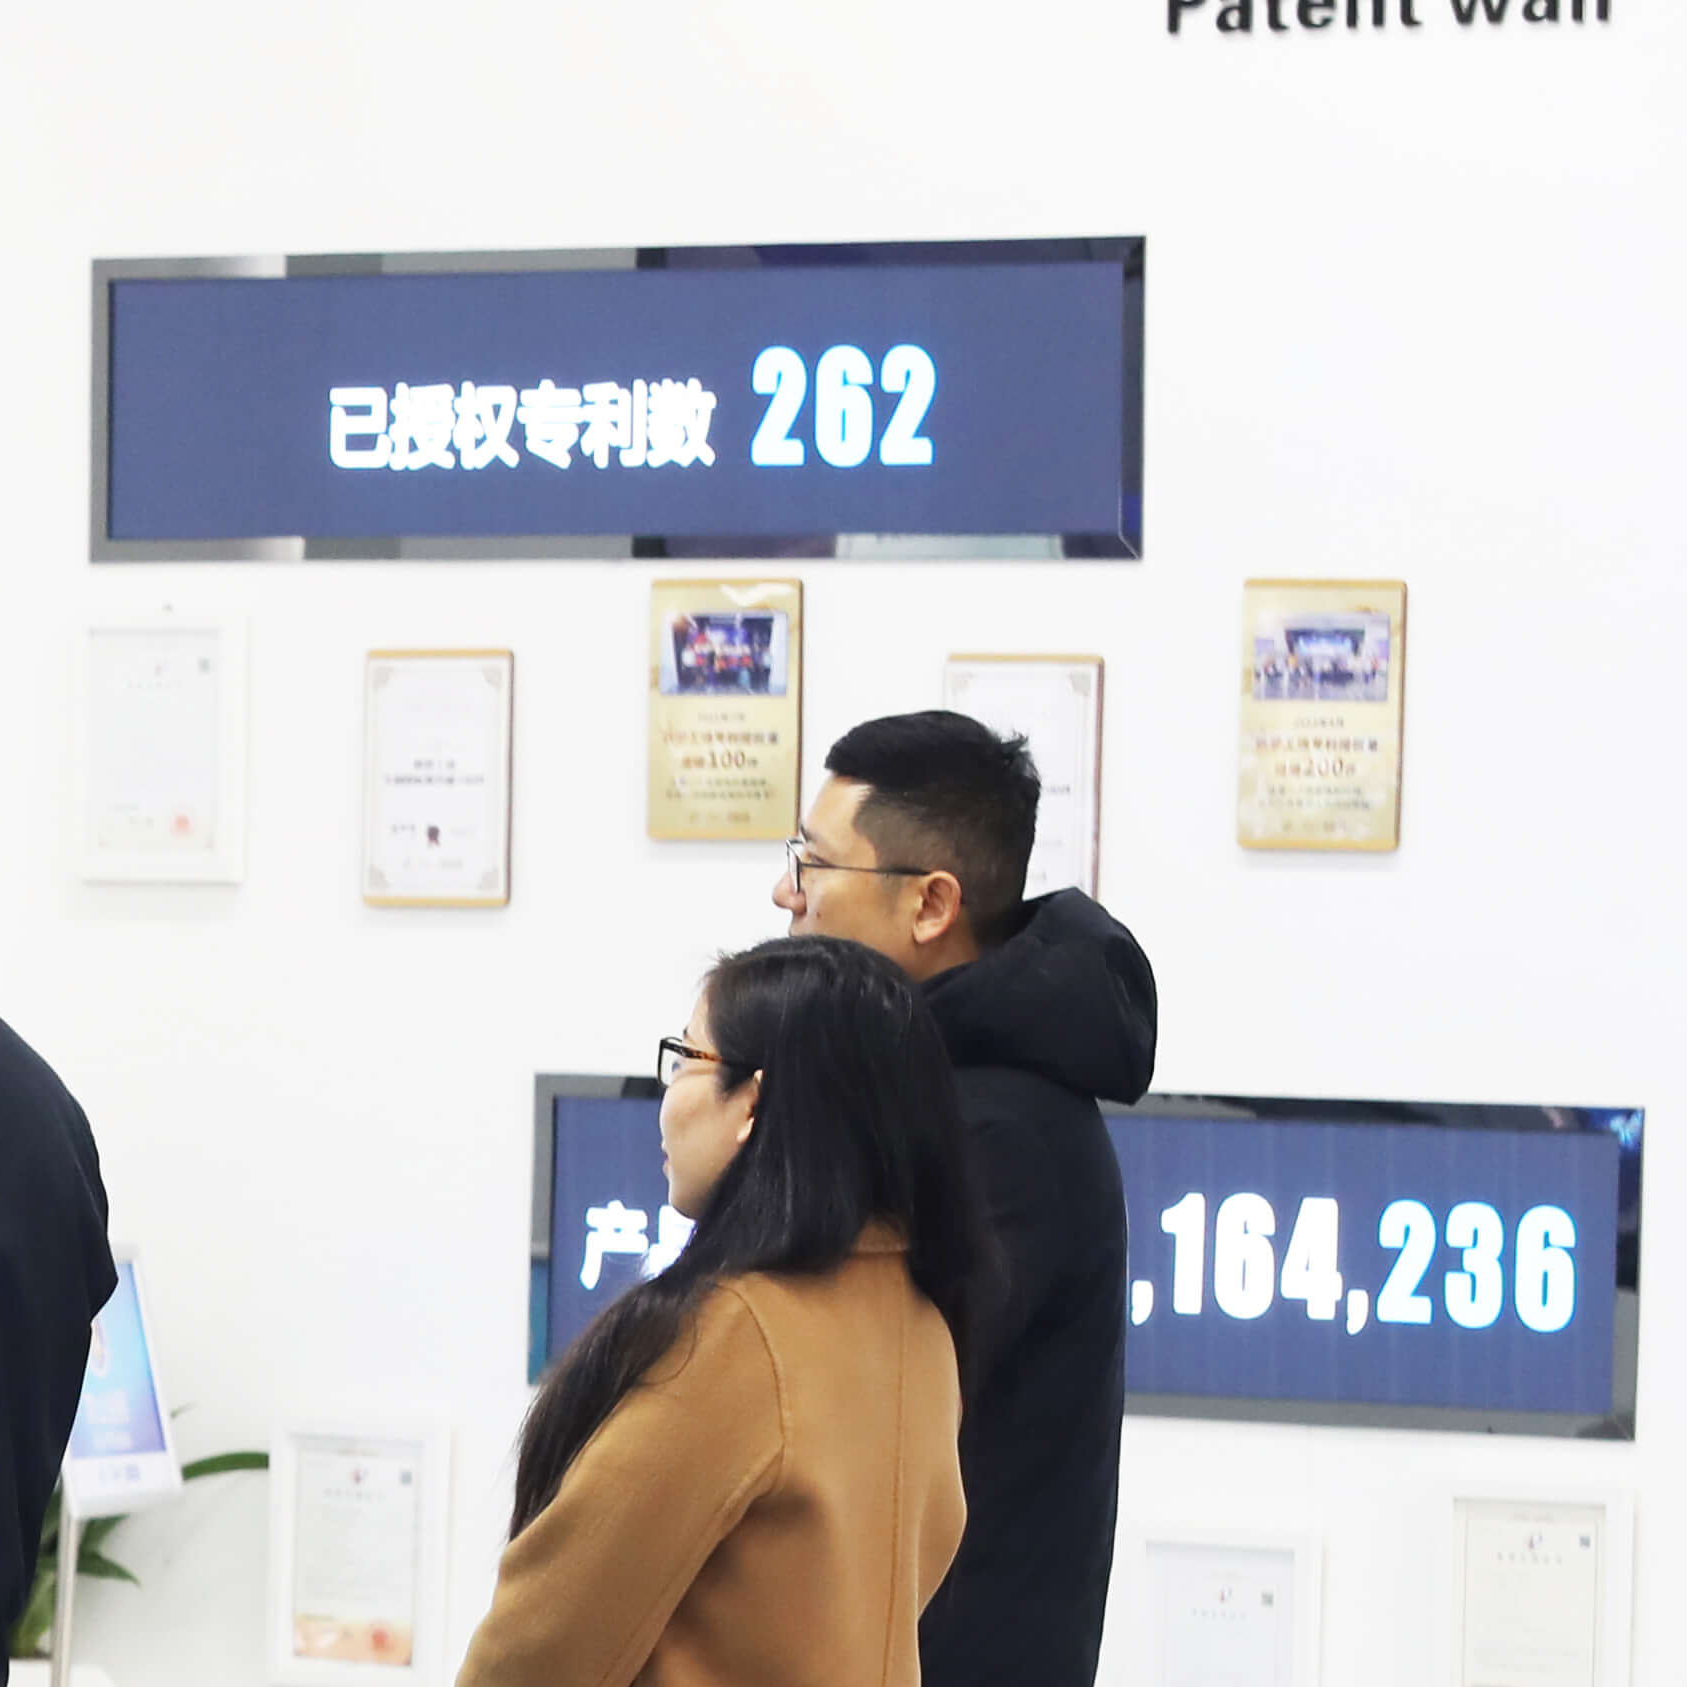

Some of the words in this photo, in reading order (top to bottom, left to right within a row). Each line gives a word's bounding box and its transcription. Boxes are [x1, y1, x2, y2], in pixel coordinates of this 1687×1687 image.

[329, 378, 717, 470] 已授权专利数
[750, 344, 937, 468] 262
